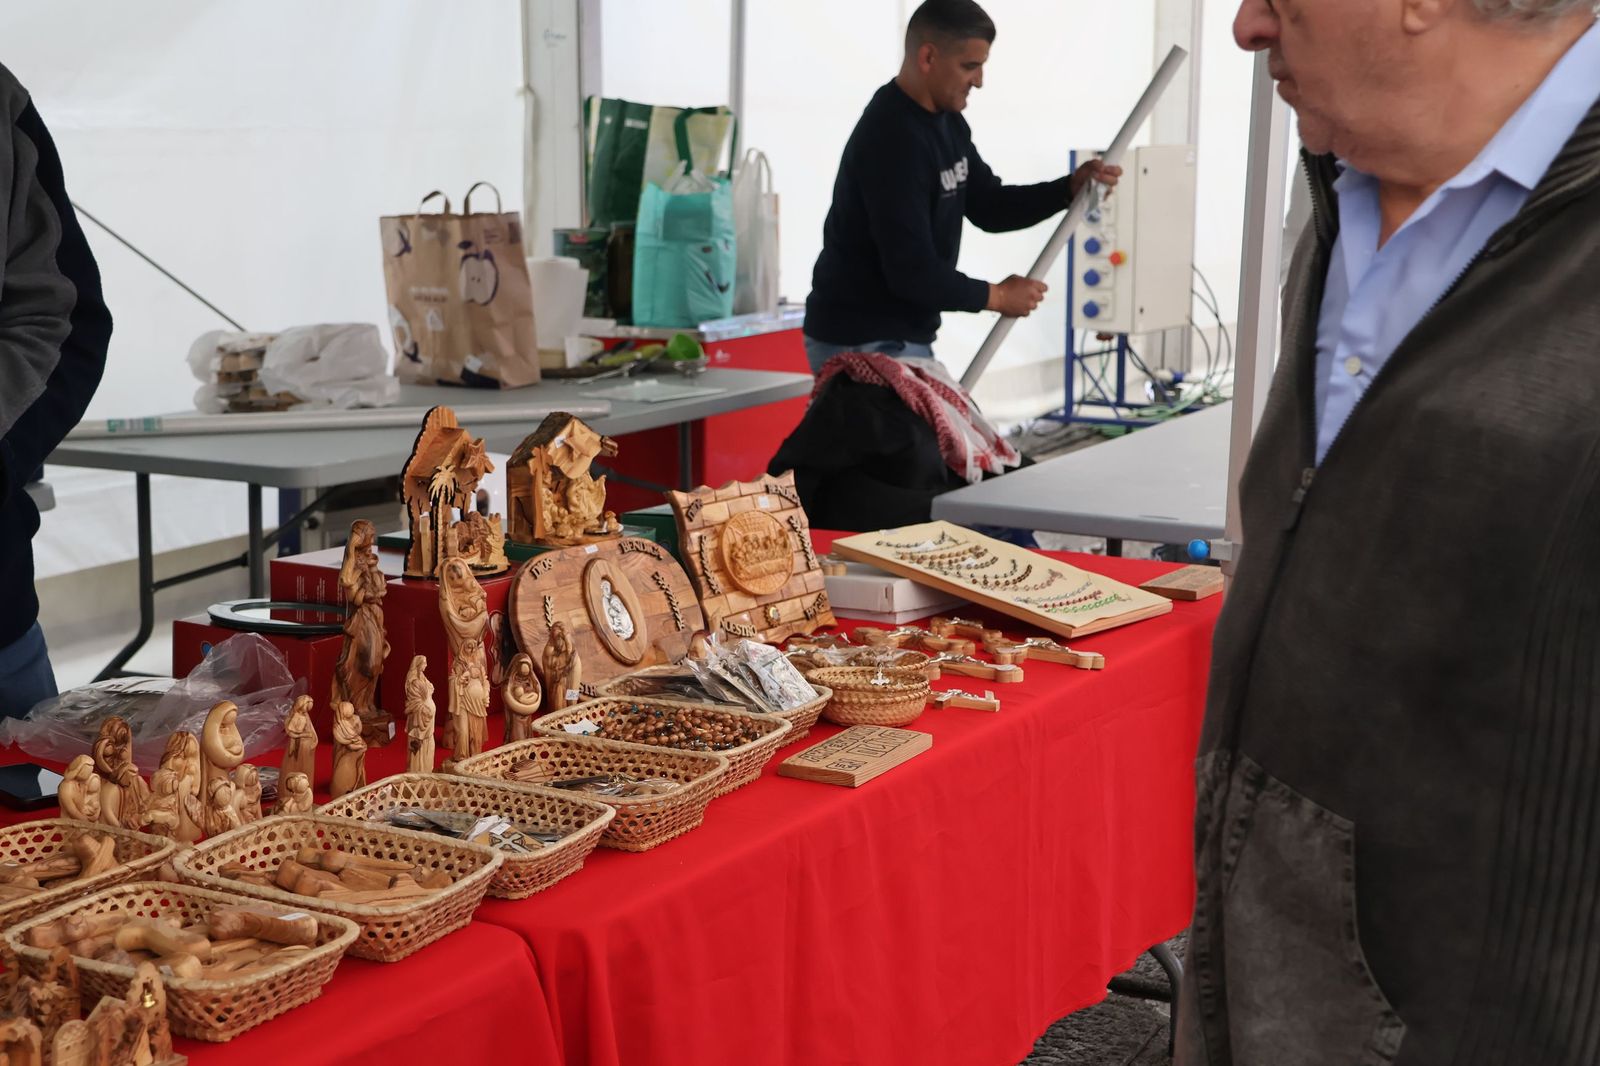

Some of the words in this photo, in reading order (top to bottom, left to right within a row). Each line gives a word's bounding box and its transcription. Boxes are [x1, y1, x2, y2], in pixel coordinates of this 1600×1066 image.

[530, 558, 553, 580] DIOS
[618, 540, 663, 561] BENDIGA
[719, 619, 758, 638] NUESTRO
